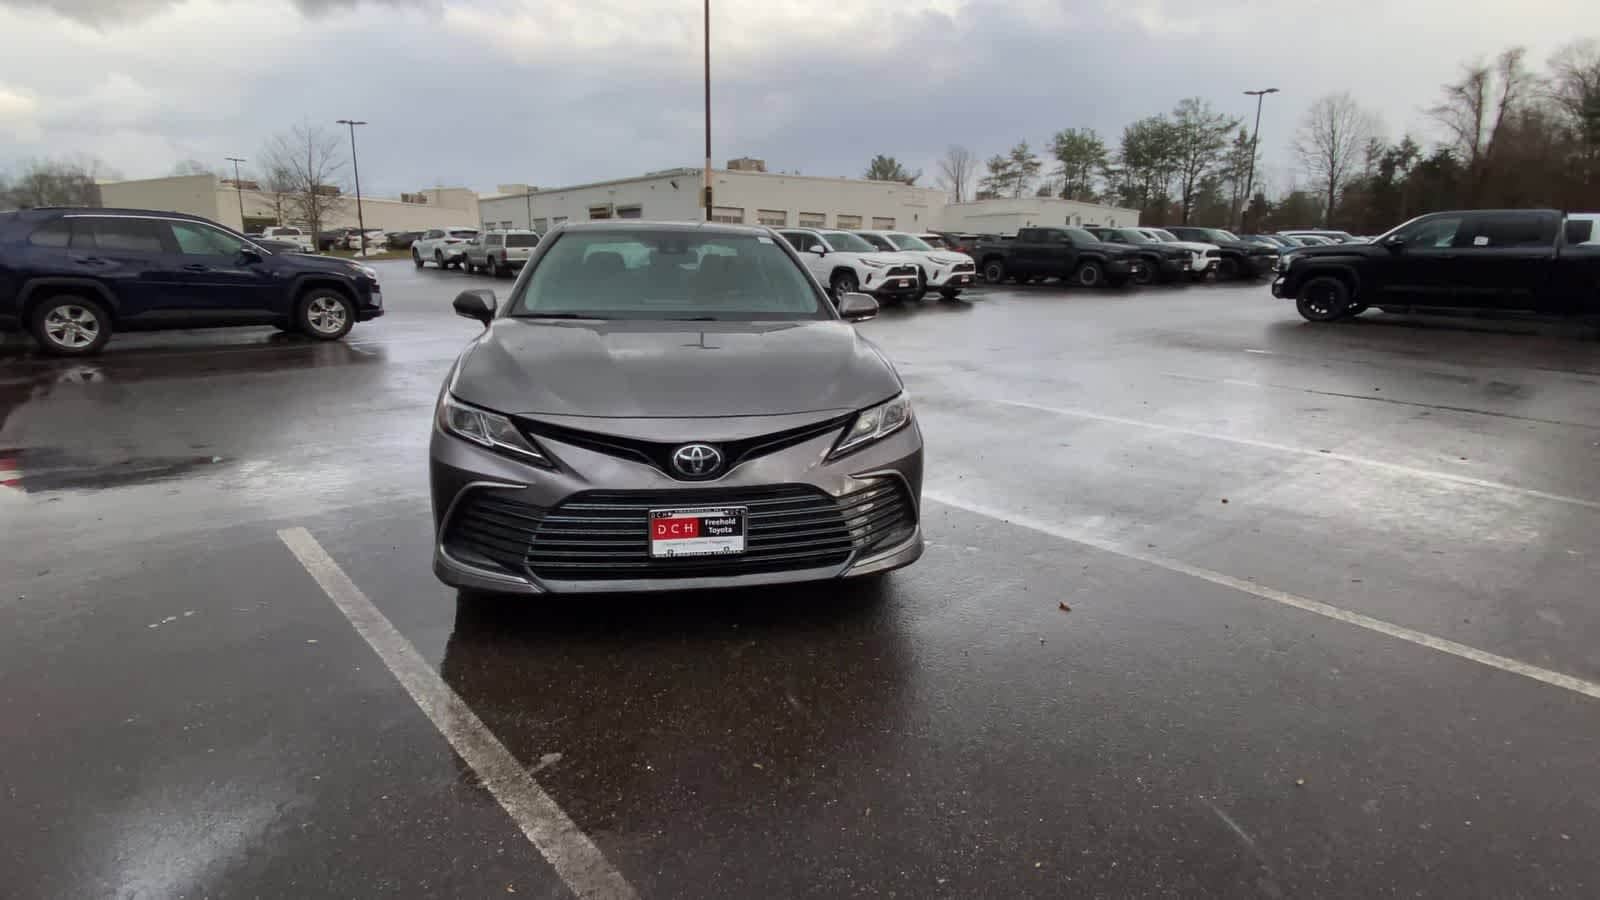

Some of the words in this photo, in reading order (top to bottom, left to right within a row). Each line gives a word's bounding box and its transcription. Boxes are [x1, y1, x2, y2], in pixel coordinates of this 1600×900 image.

[705, 518, 736, 526] Freehold
[658, 523, 693, 534] DCH
[708, 526, 733, 535] Toyota
